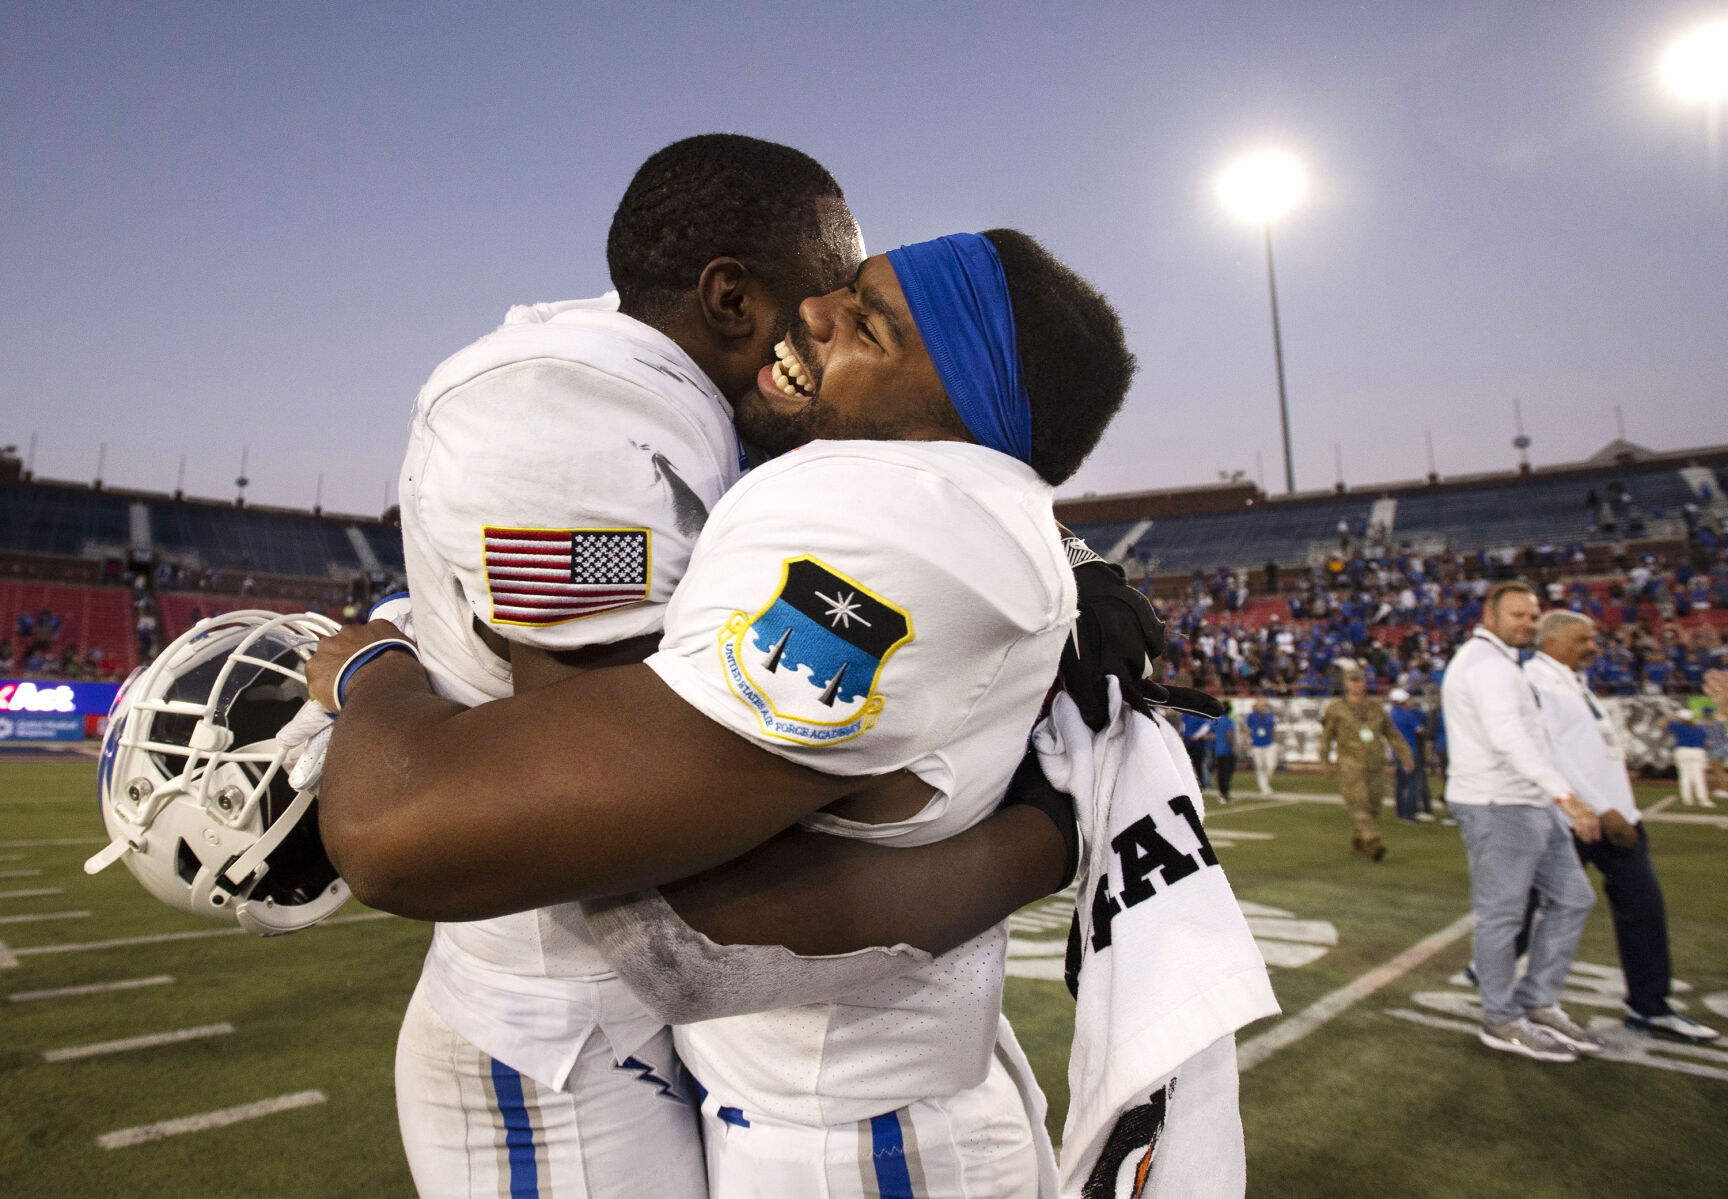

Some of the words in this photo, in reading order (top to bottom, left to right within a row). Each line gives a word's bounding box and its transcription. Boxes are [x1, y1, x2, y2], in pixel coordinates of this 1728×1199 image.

[725, 643, 742, 682] UNITED
[738, 681, 766, 710] STATES
[760, 710, 774, 727] AIR
[775, 722, 809, 737] FORCE
[810, 720, 861, 740] ACADEMY
